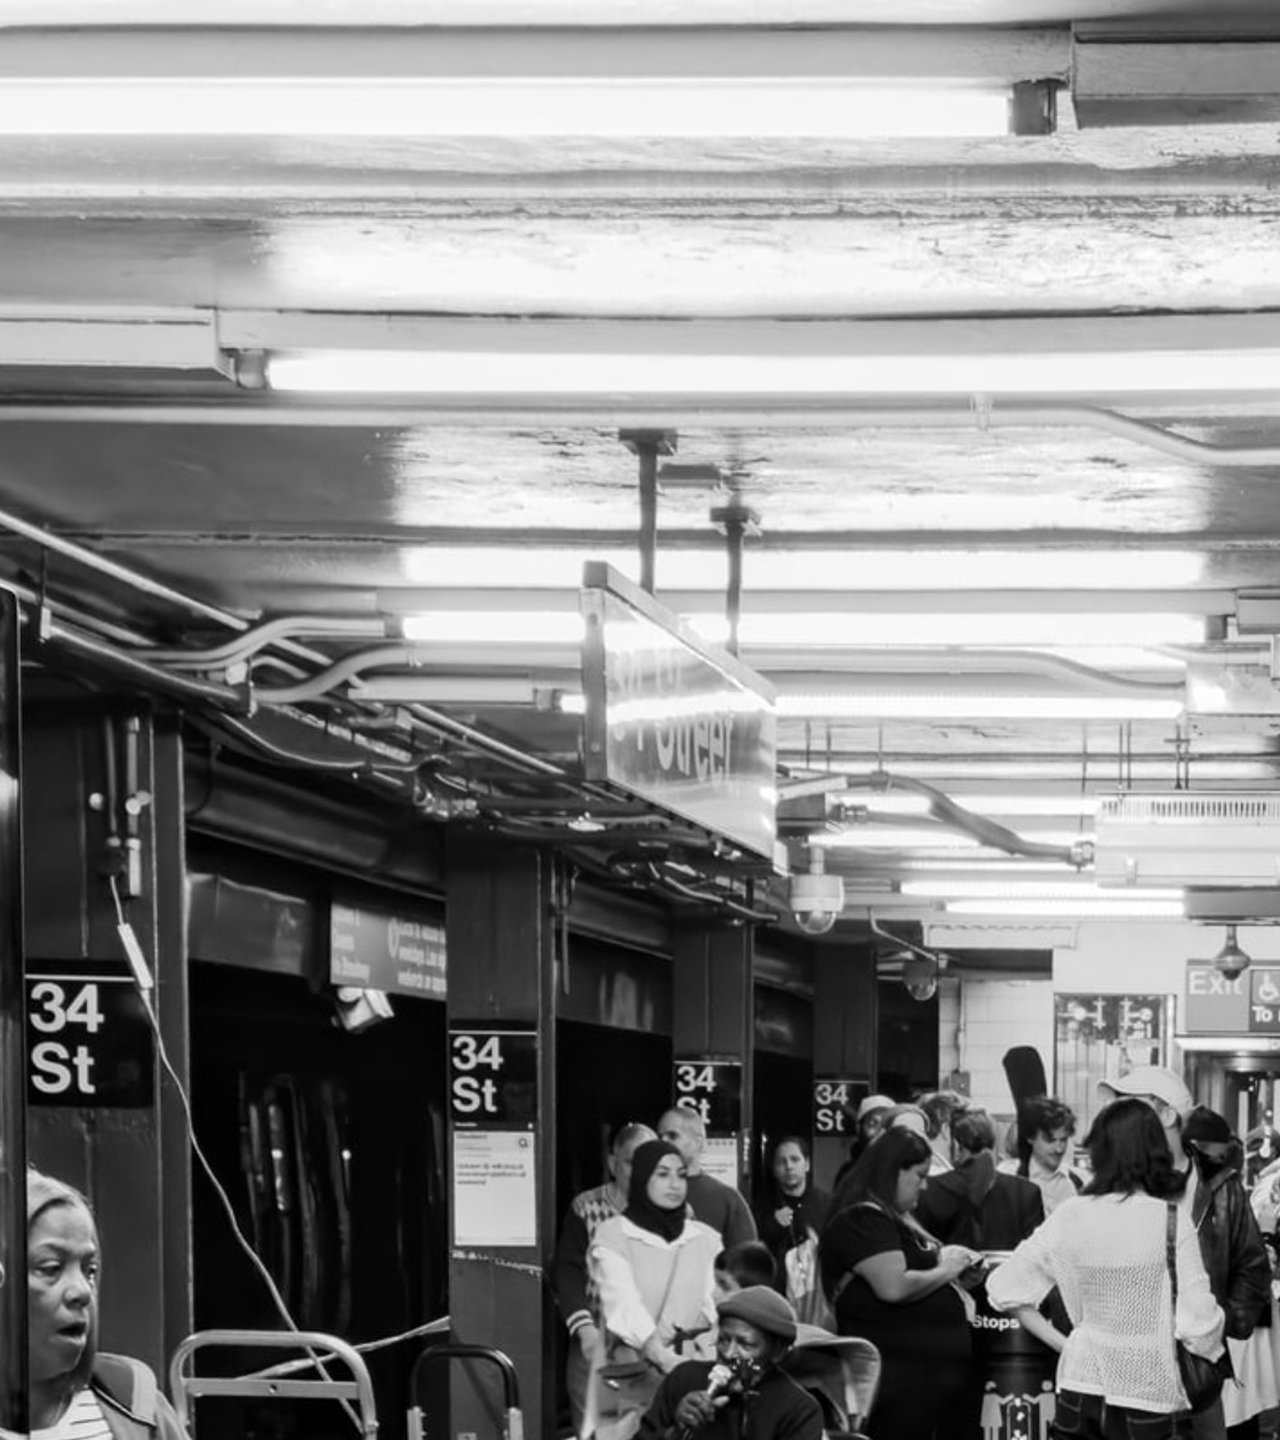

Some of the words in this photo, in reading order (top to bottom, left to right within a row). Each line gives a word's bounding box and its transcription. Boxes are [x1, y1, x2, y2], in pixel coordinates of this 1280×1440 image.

[1189, 970, 1243, 996] Exit
[29, 982, 105, 1033] 34
[1251, 1006, 1272, 1023] To
[452, 1035, 504, 1071] 34
[31, 1041, 96, 1094] St
[676, 1065, 723, 1093] 34
[452, 1076, 498, 1113] St
[815, 1081, 849, 1106] 34
[816, 1108, 844, 1131] St
